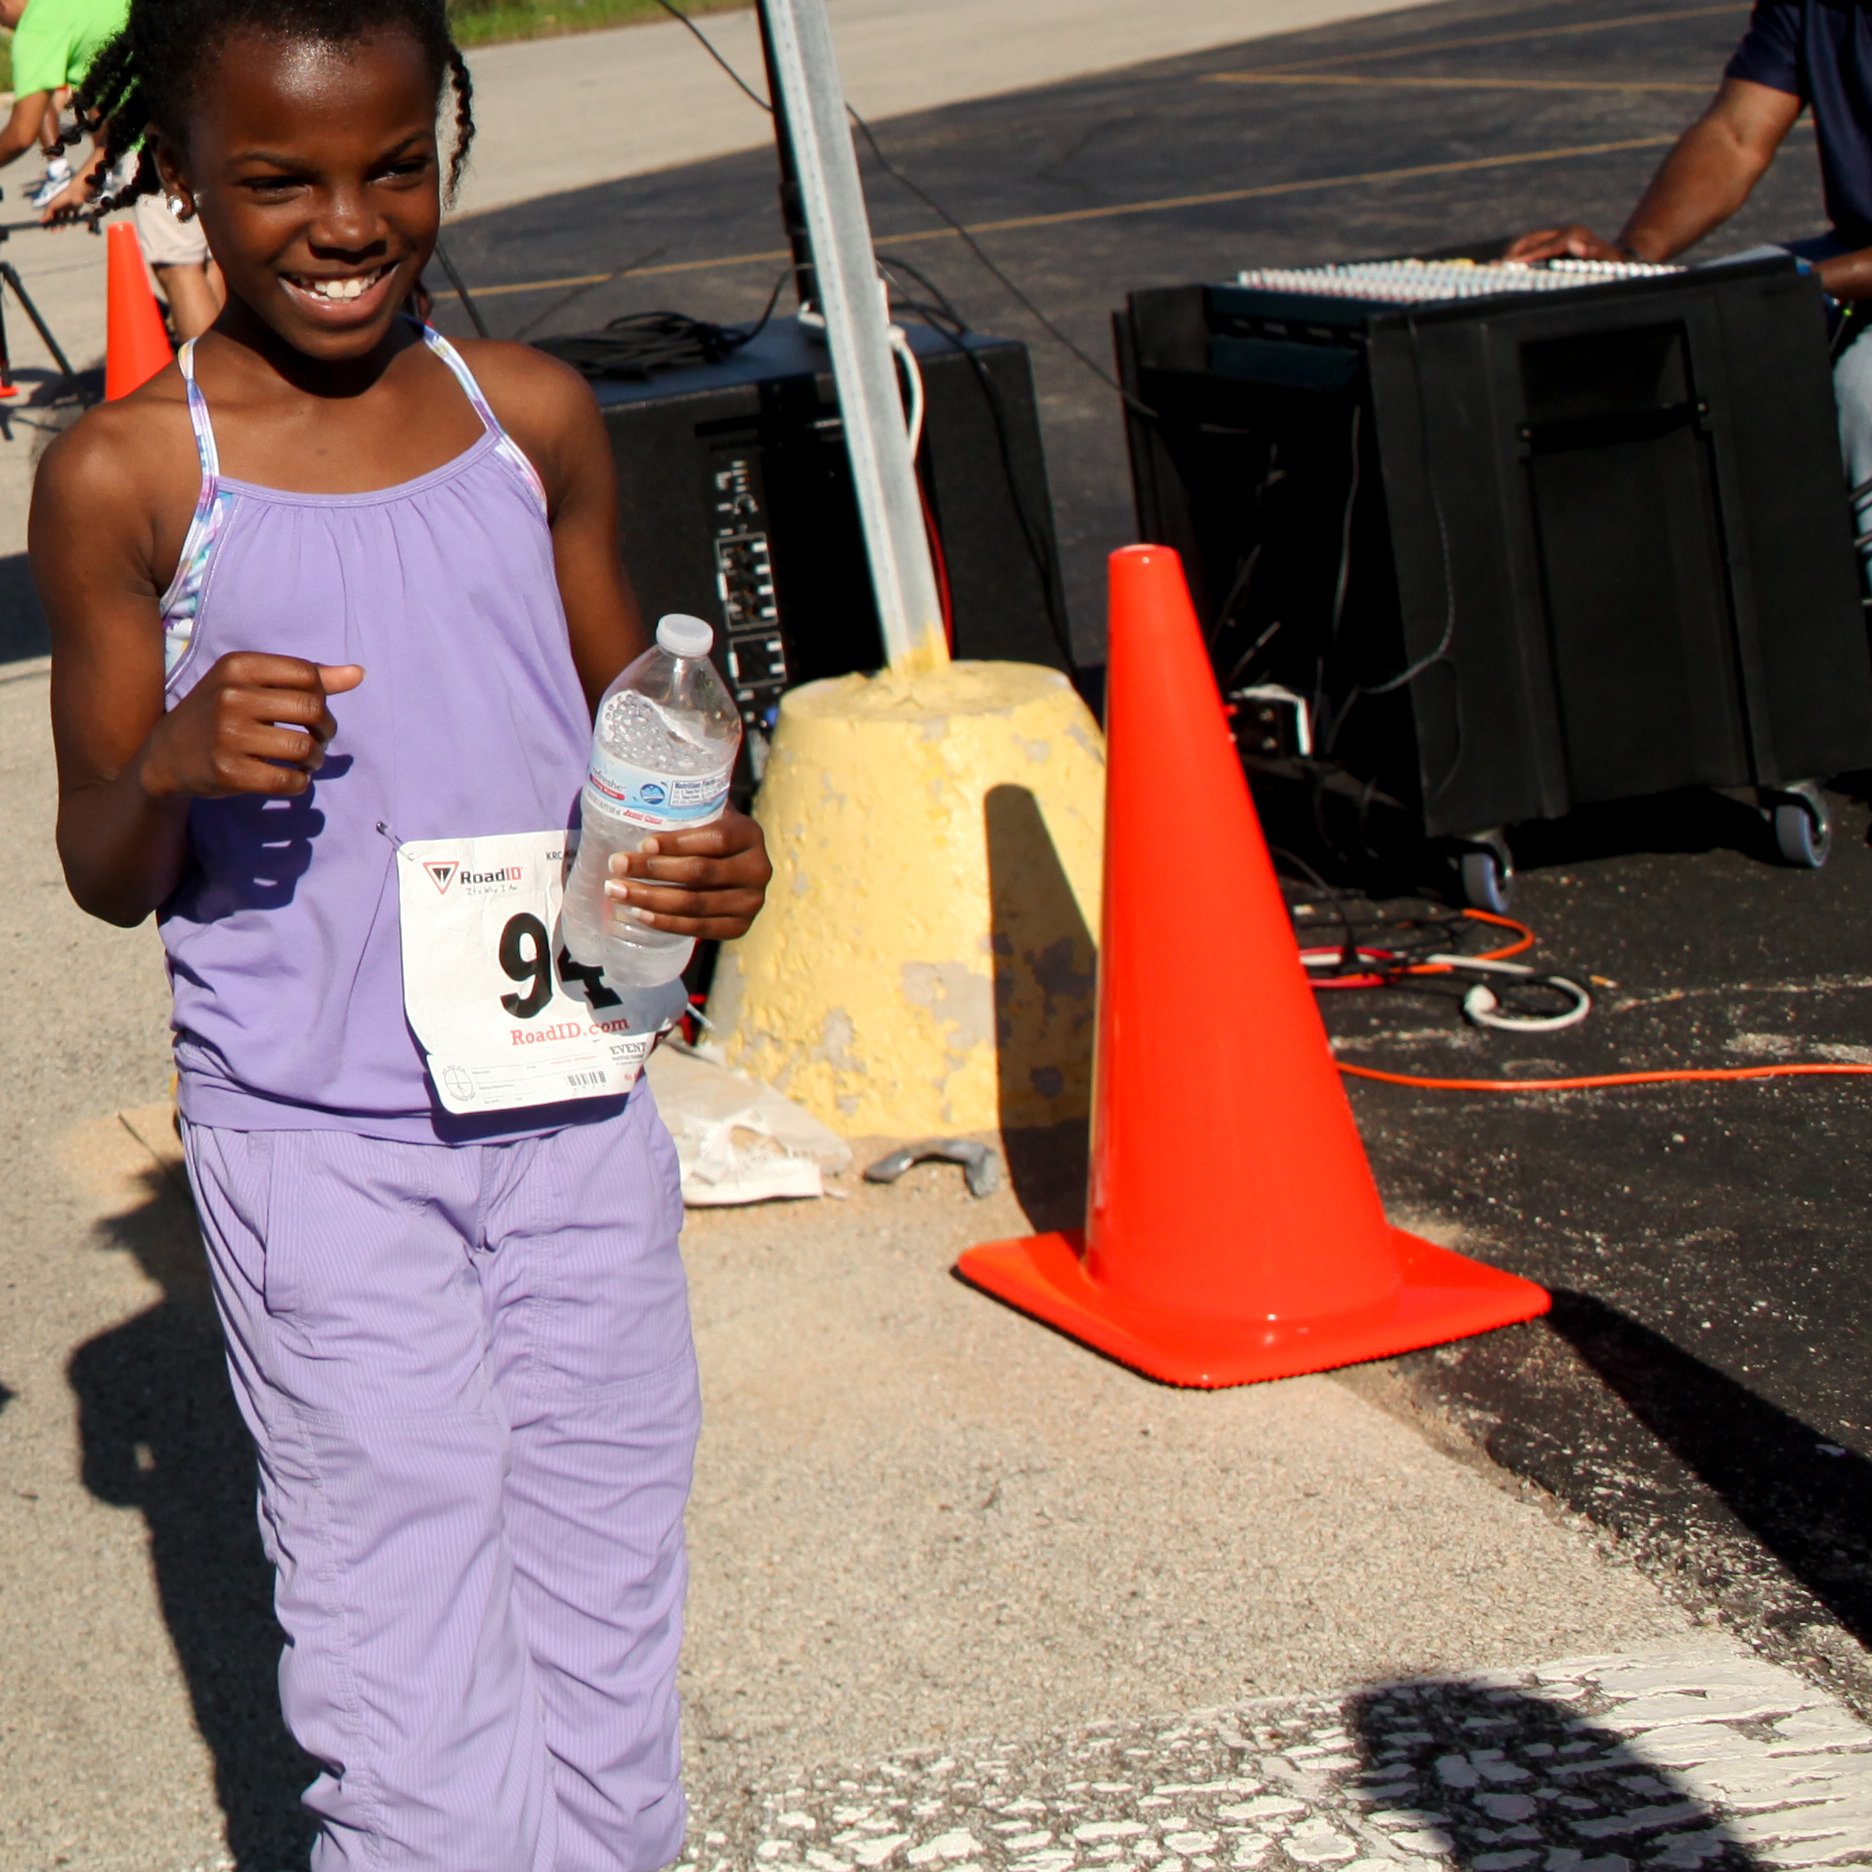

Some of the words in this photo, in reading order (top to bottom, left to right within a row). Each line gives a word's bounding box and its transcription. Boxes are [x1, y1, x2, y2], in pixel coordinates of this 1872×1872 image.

[460, 866, 522, 885] RoadID
[546, 851, 562, 861] KRC
[511, 1017, 630, 1045] RoadID.com
